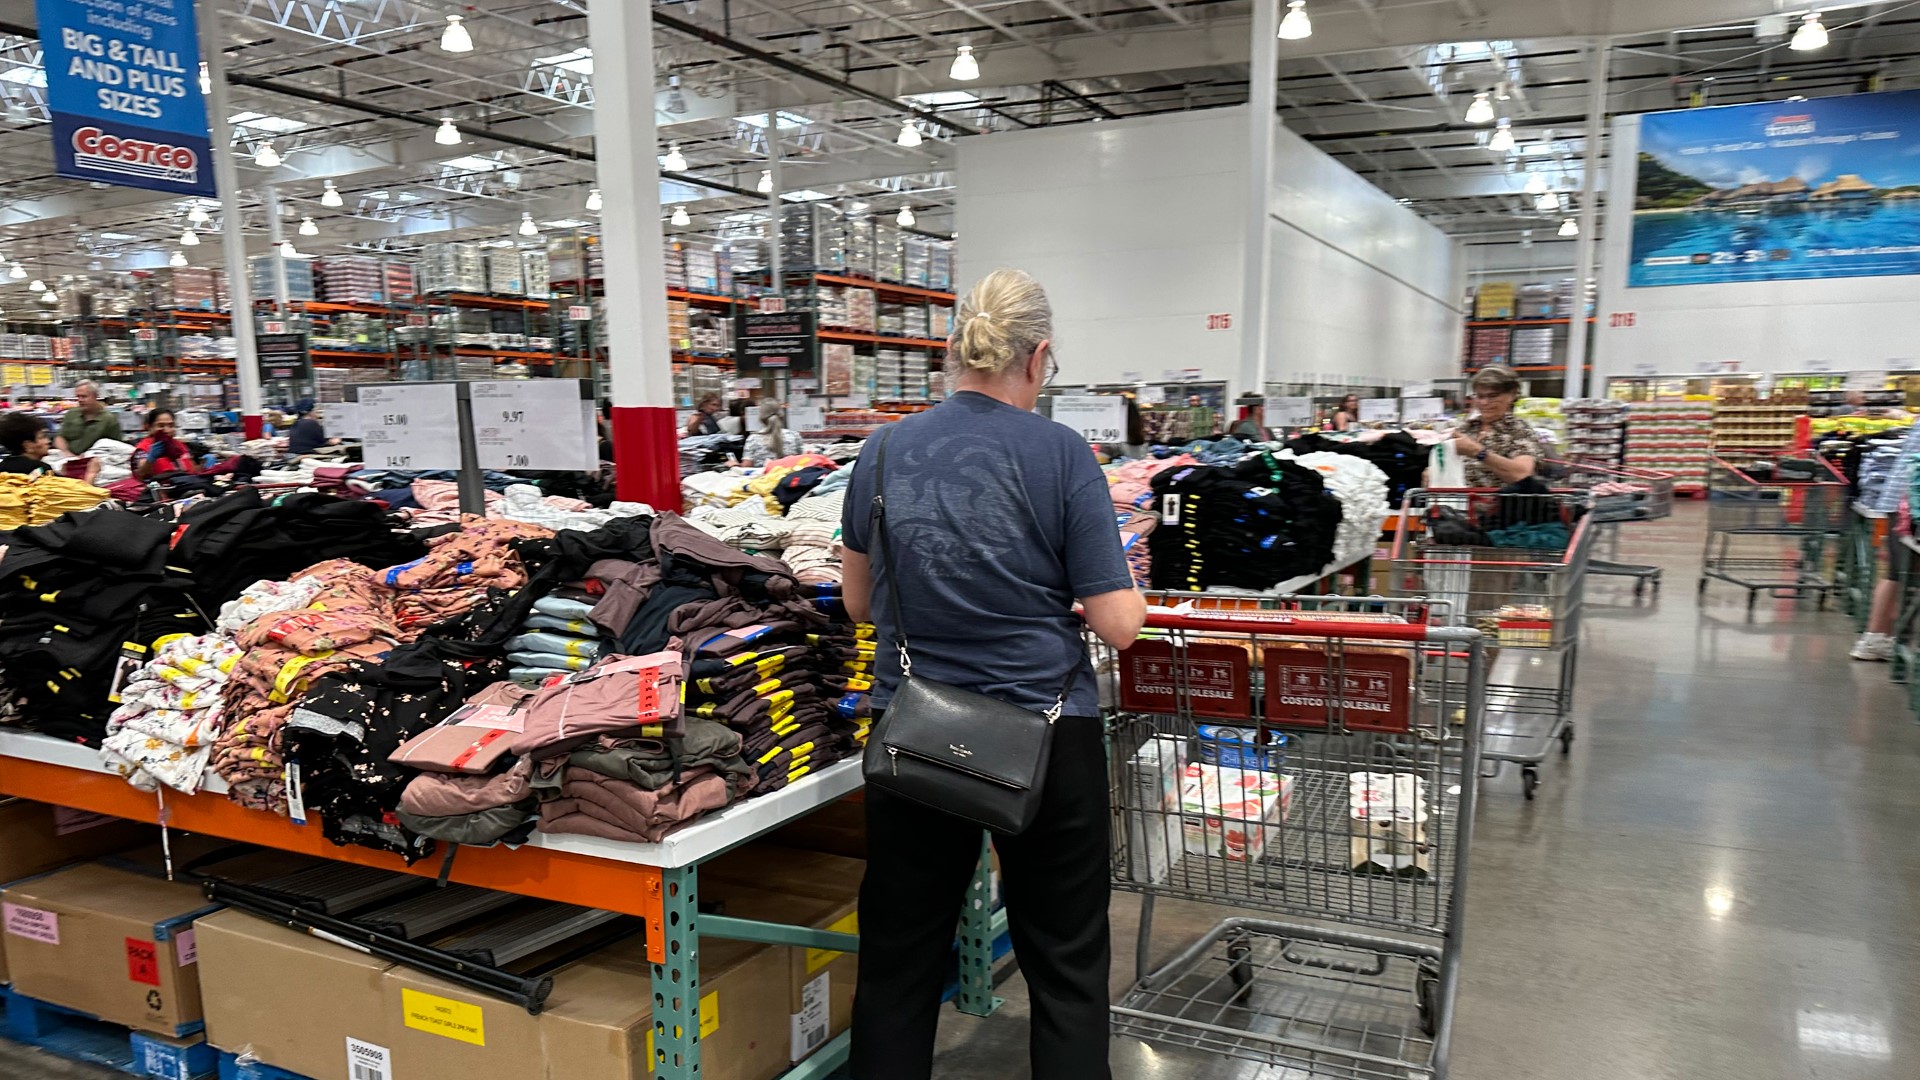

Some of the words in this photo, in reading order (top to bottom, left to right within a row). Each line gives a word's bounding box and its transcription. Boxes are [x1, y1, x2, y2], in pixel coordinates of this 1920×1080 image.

[86, 9, 154, 40] including
[62, 27, 105, 57] BIG
[108, 39, 128, 62] &
[128, 44, 187, 74] TALL
[68, 56, 124, 85] AND
[128, 67, 187, 98] PLUS
[97, 88, 163, 118] SIZES
[73, 127, 197, 171] COSTCO
[383, 414, 408, 426] 15.00
[502, 410, 525, 423] 9.97
[386, 456, 411, 467] 14.97
[507, 454, 529, 467] 7.00
[1135, 684, 1174, 696] COSTCO
[1281, 695, 1323, 708] COSTCO
